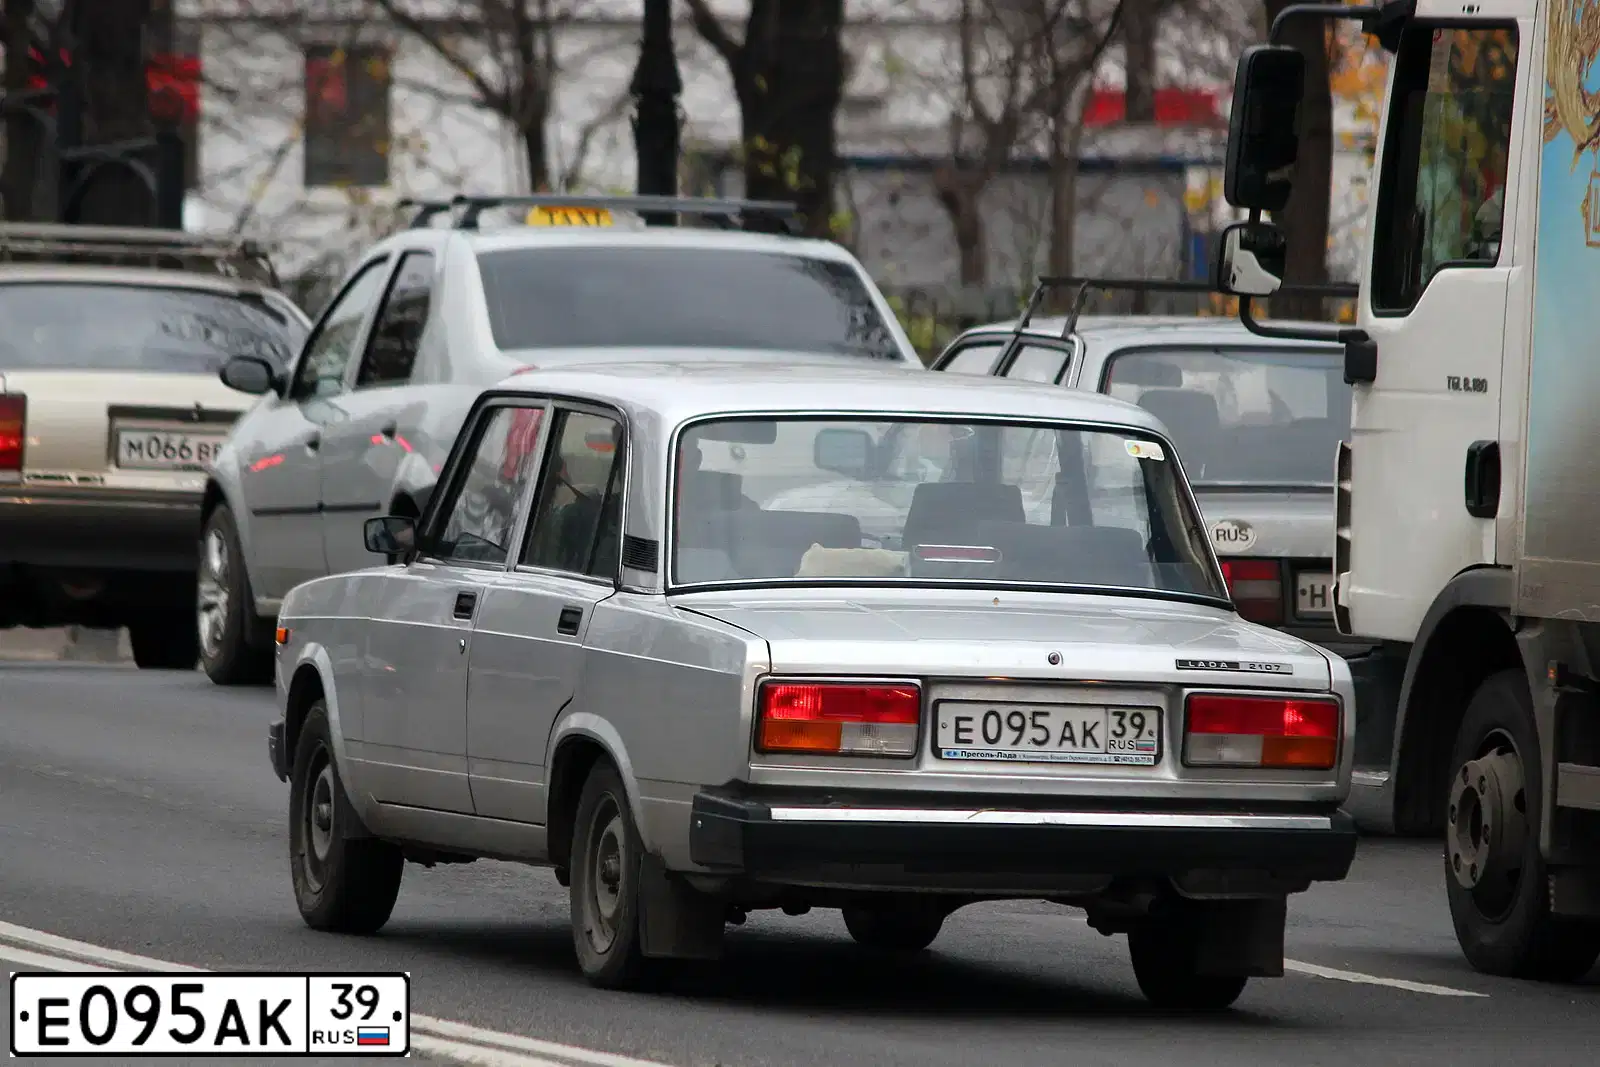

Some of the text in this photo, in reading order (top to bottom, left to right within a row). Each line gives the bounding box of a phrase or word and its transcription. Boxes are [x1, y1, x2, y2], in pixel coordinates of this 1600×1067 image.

[1215, 528, 1249, 541] RUS
[1188, 660, 1281, 671] LADA 2107
[1111, 710, 1146, 739] 39
[1108, 739, 1135, 750] RUS
